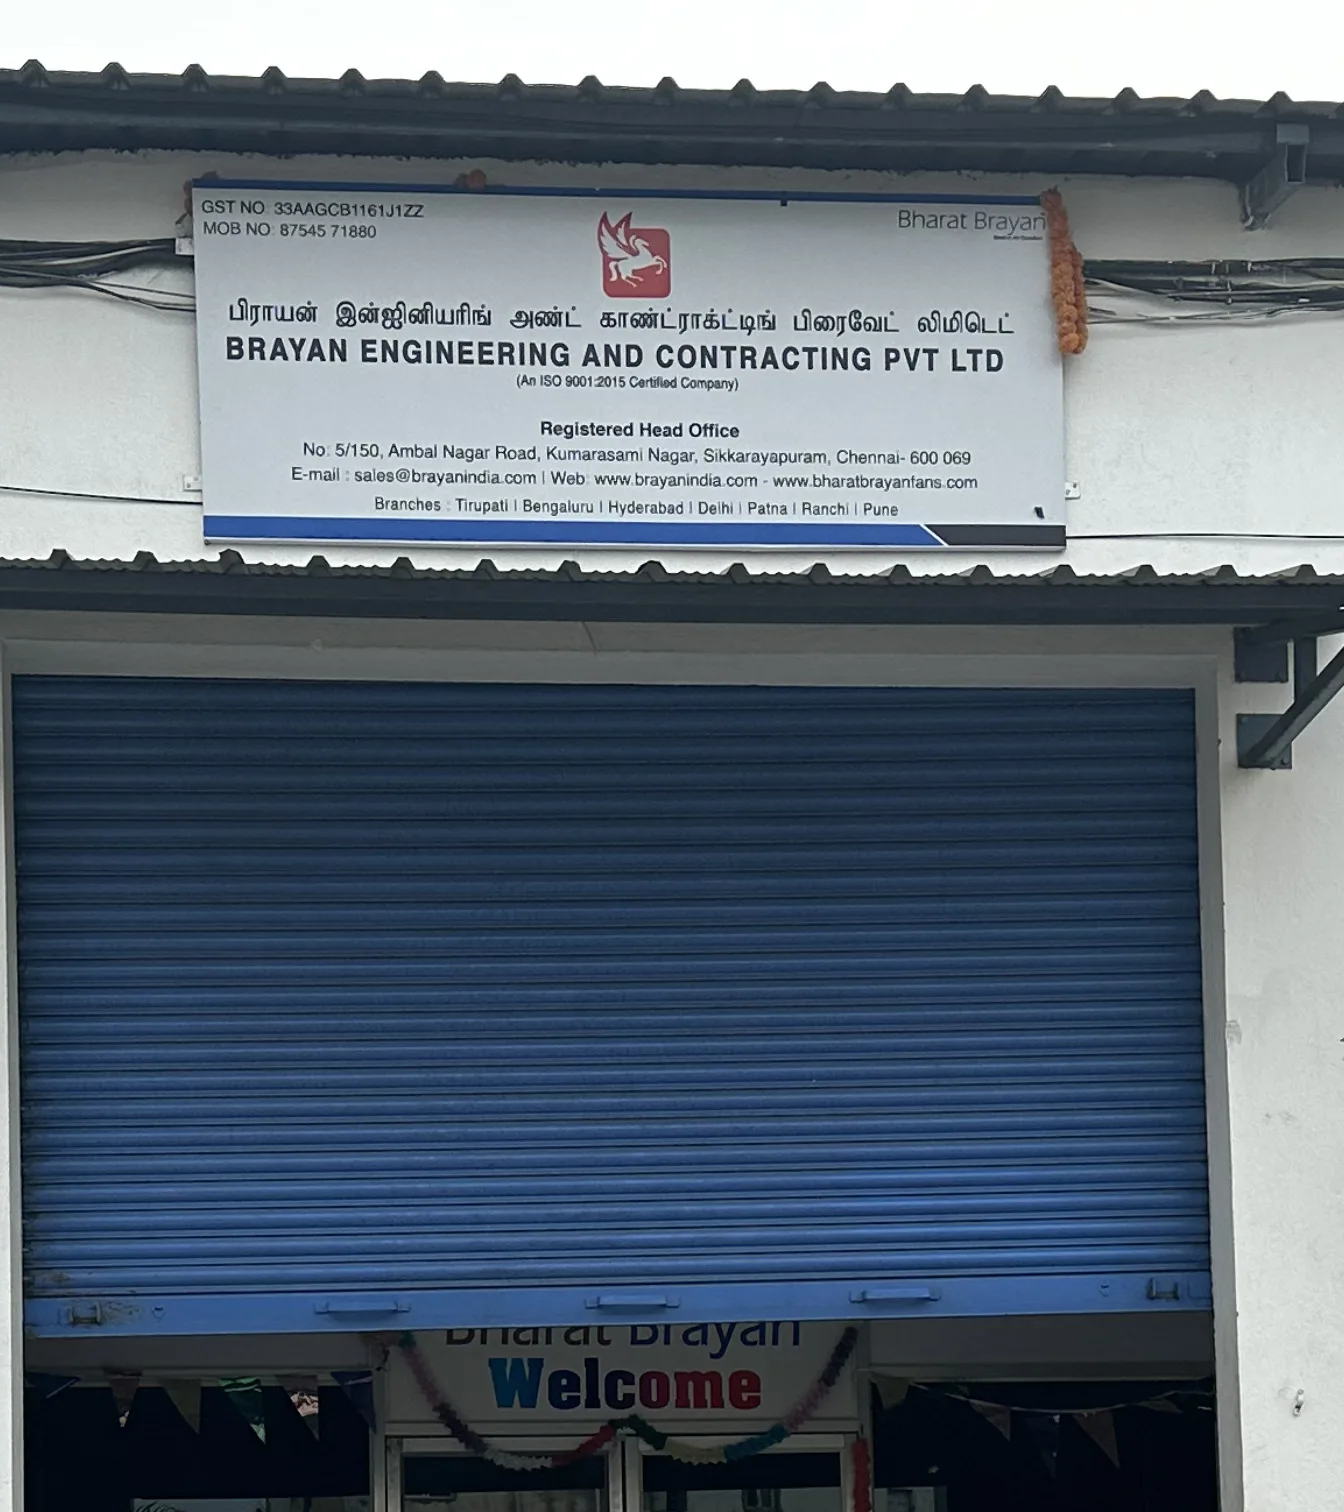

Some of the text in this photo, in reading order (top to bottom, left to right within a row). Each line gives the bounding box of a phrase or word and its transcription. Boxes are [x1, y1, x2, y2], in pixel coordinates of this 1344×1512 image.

[202, 200, 236, 214] GST
[274, 202, 425, 218] 33AAGCB1161J1ZZ
[204, 221, 241, 235] MOB
[280, 223, 326, 238] 87545
[331, 224, 377, 239] 71880
[898, 209, 1046, 236] Bharat Brayan
[229, 298, 1015, 337] பிராயன் இன்ஜினியரிங் அண்ட் காண்ட்ராக்ட்டிங் பிரைவேட் லிமிடெட்
[226, 336, 1004, 373] BRAYAN ENGINEERING AND CONTRACTING PVT LTD
[517, 374, 739, 392] (An ISO 9001:2015 Certified Company)
[540, 421, 740, 439] Registered Head Office
[335, 443, 384, 459] 5/150,
[388, 444, 437, 459] Ambal
[443, 445, 490, 463] Nagar
[495, 446, 541, 462] Road,
[546, 447, 643, 462] Kumarasami
[648, 448, 698, 466] Nagar,
[703, 448, 831, 468] Sikkarayapuram,
[910, 451, 939, 466] 600
[943, 451, 972, 466] 069
[291, 467, 340, 482] E-mail
[354, 468, 537, 487] sales@brayanindia.com
[594, 473, 758, 491] www.brayanindia.com
[772, 474, 979, 492] www.bharatbrayanfans.com
[375, 497, 441, 512] Branches
[455, 498, 509, 515] Tirupati
[523, 499, 594, 516] Bengaluru
[608, 500, 684, 518] Hyderabad
[698, 501, 734, 515] Delhi
[748, 502, 788, 516] Patna
[802, 502, 849, 516] Ranchi
[863, 503, 899, 517] Pune
[488, 1357, 762, 1410] Welcome
